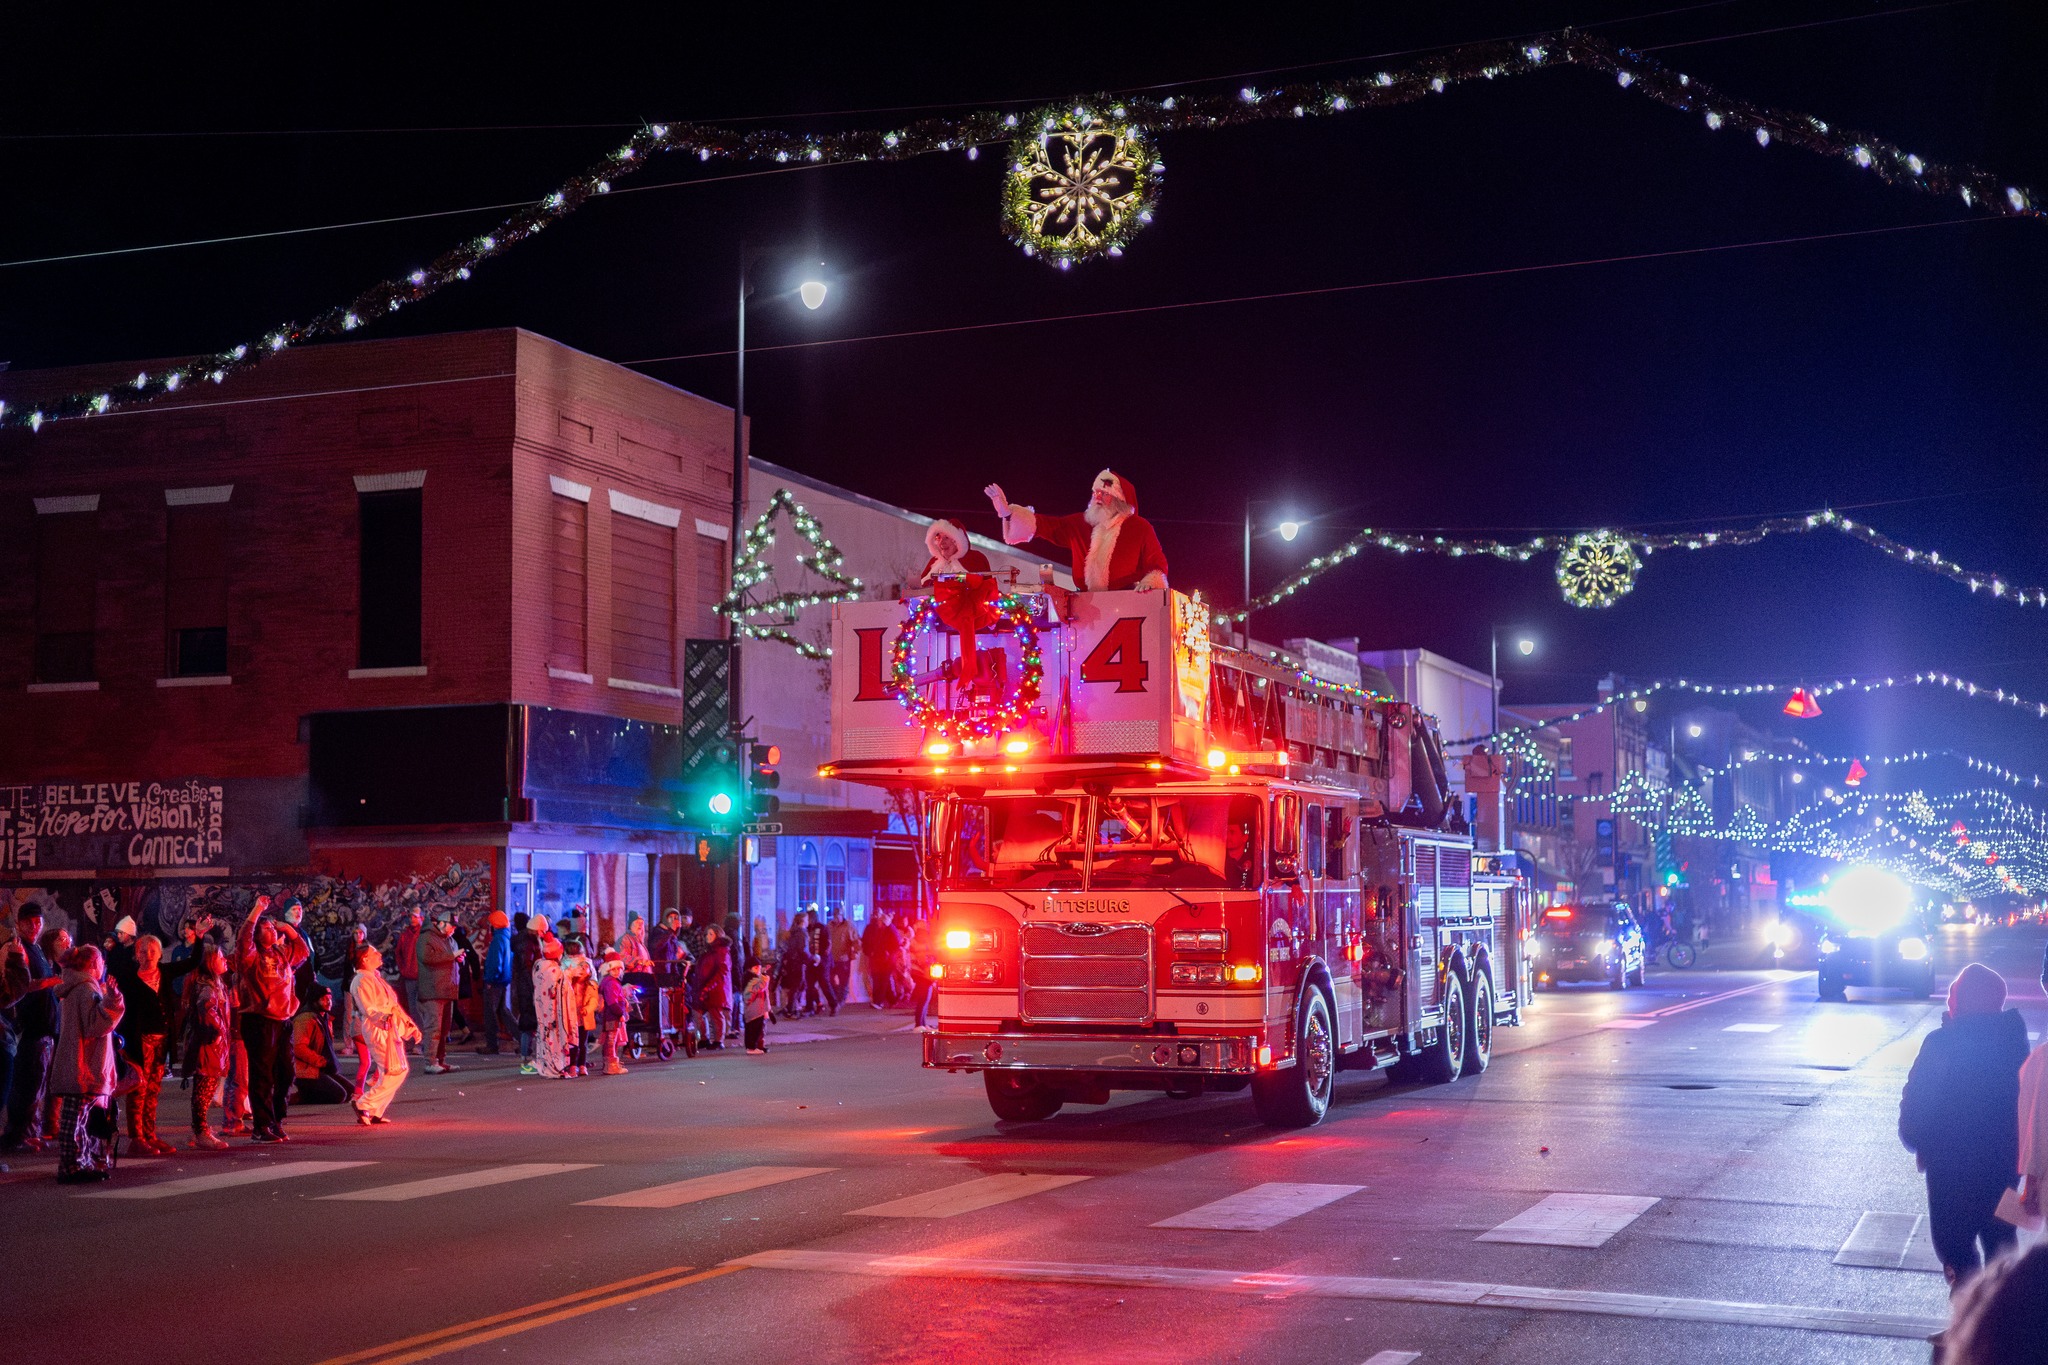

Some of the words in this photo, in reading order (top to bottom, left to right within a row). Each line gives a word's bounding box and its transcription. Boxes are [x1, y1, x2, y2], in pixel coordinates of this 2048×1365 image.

[1080, 617, 1149, 694] 4
[715, 660, 729, 679] DOW
[715, 689, 728, 709] DOW
[716, 721, 729, 739] DOW
[46, 782, 146, 806] BELIEVE.
[1042, 899, 1131, 914] PITTSBURG
